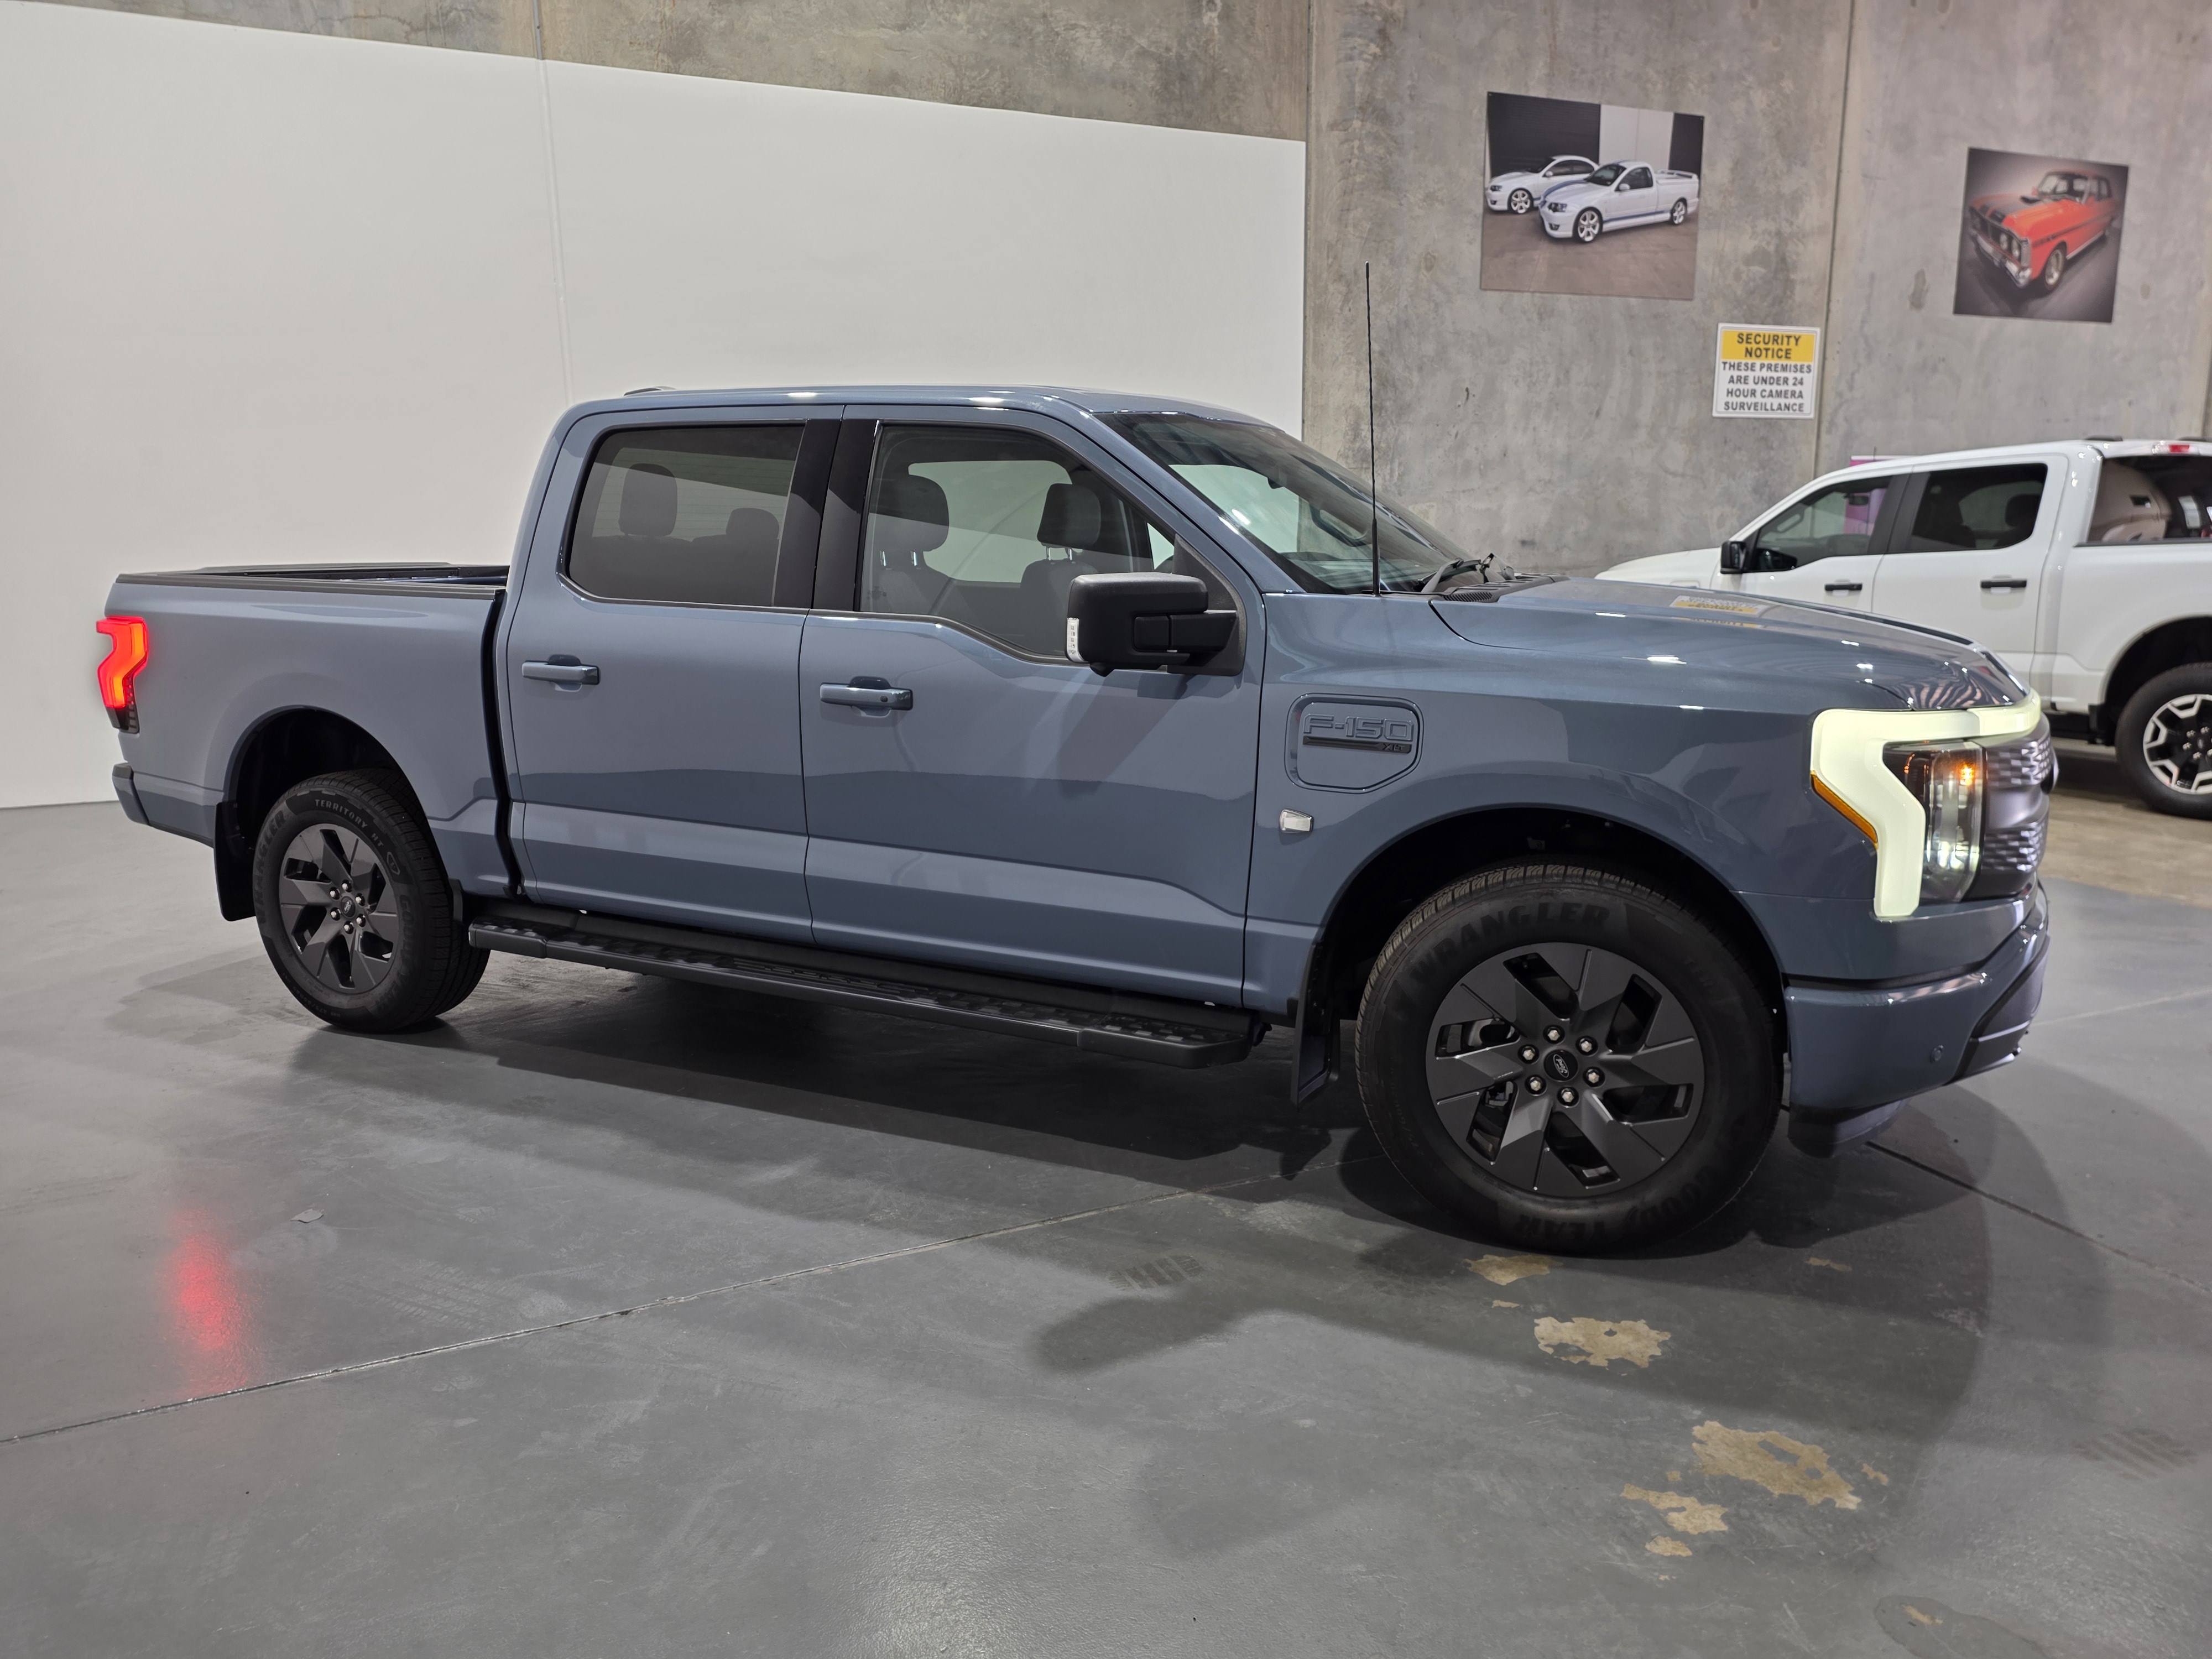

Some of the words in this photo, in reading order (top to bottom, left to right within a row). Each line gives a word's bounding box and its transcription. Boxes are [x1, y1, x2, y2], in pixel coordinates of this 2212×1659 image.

[1737, 333, 1801, 346] SECURITY
[1745, 347, 1792, 359] NOTICE
[1722, 361, 1756, 372] THESE
[1759, 362, 1812, 373] PREMISES
[1728, 375, 1749, 384] ARE
[1753, 375, 1789, 386] UNDER
[1792, 377, 1804, 386] 24
[1726, 388, 1756, 398] HOUR
[1760, 389, 1804, 399] CAMERA
[1724, 401, 1804, 412] SURVEILLANCE
[1303, 713, 1414, 742] F-150
[1382, 743, 1406, 752] XLT
[315, 799, 368, 828] TERRITORY
[371, 833, 385, 847] HT
[1410, 901, 1610, 985] WRANGLER
